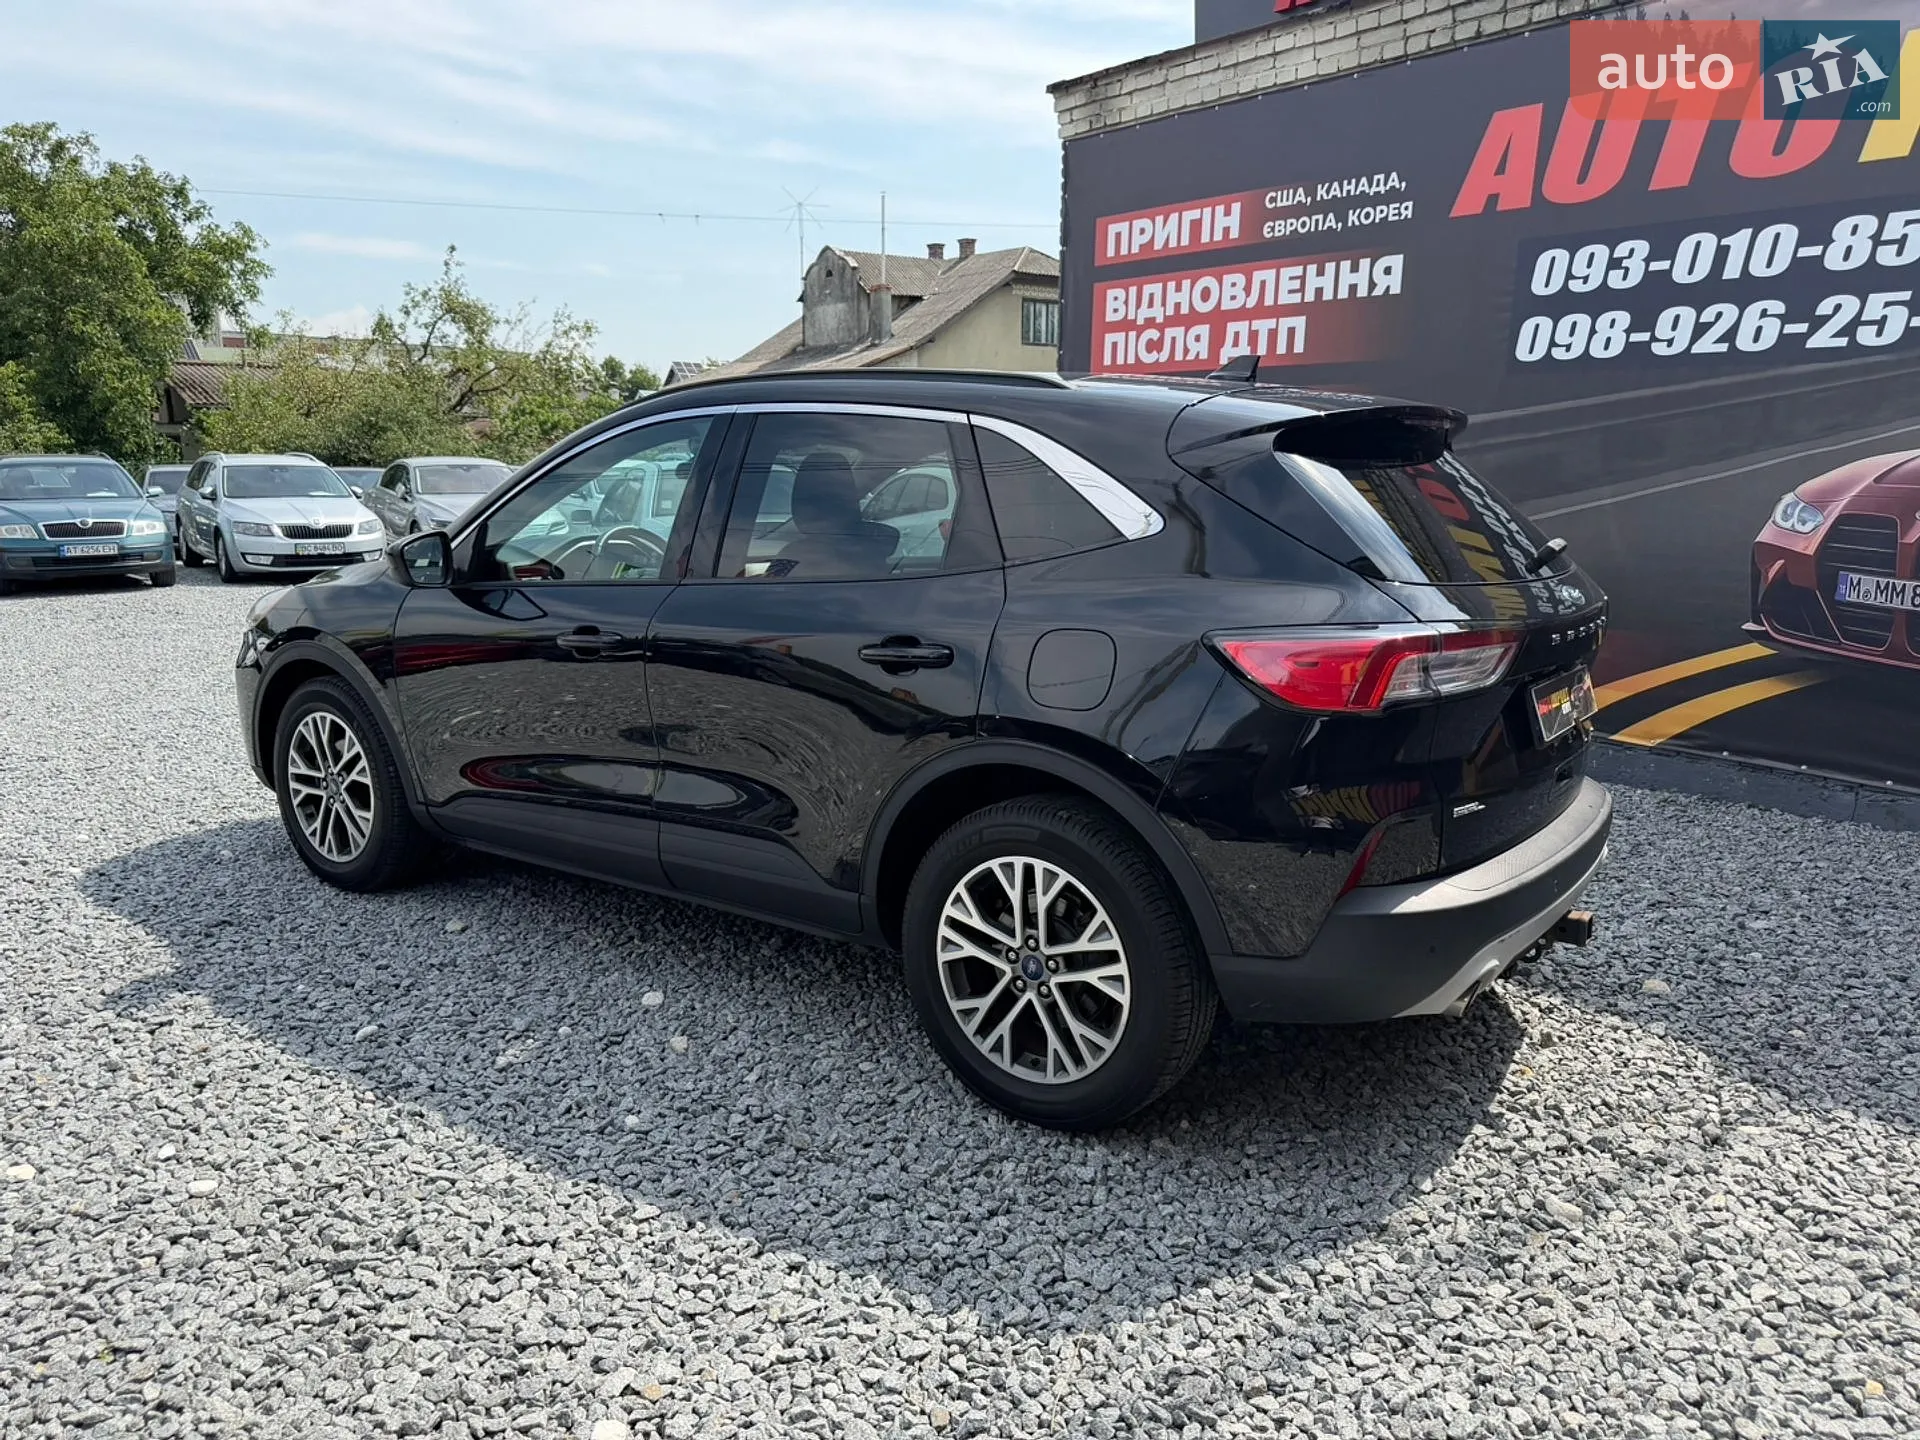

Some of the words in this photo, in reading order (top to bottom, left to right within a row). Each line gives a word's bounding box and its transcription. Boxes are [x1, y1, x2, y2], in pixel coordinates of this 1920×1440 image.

[1265, 184, 1312, 209] США,
[1316, 171, 1407, 201] КАНАДА,
[1106, 202, 1242, 258] ПРИГІН
[1262, 212, 1342, 238] ЄВРОПА,
[1347, 201, 1414, 227] КОРЕЯ
[1104, 254, 1405, 325] ВІДНОВЛЕННЯ
[1103, 323, 1210, 366] ПІСЛЯ
[1219, 316, 1307, 365] ДТП
